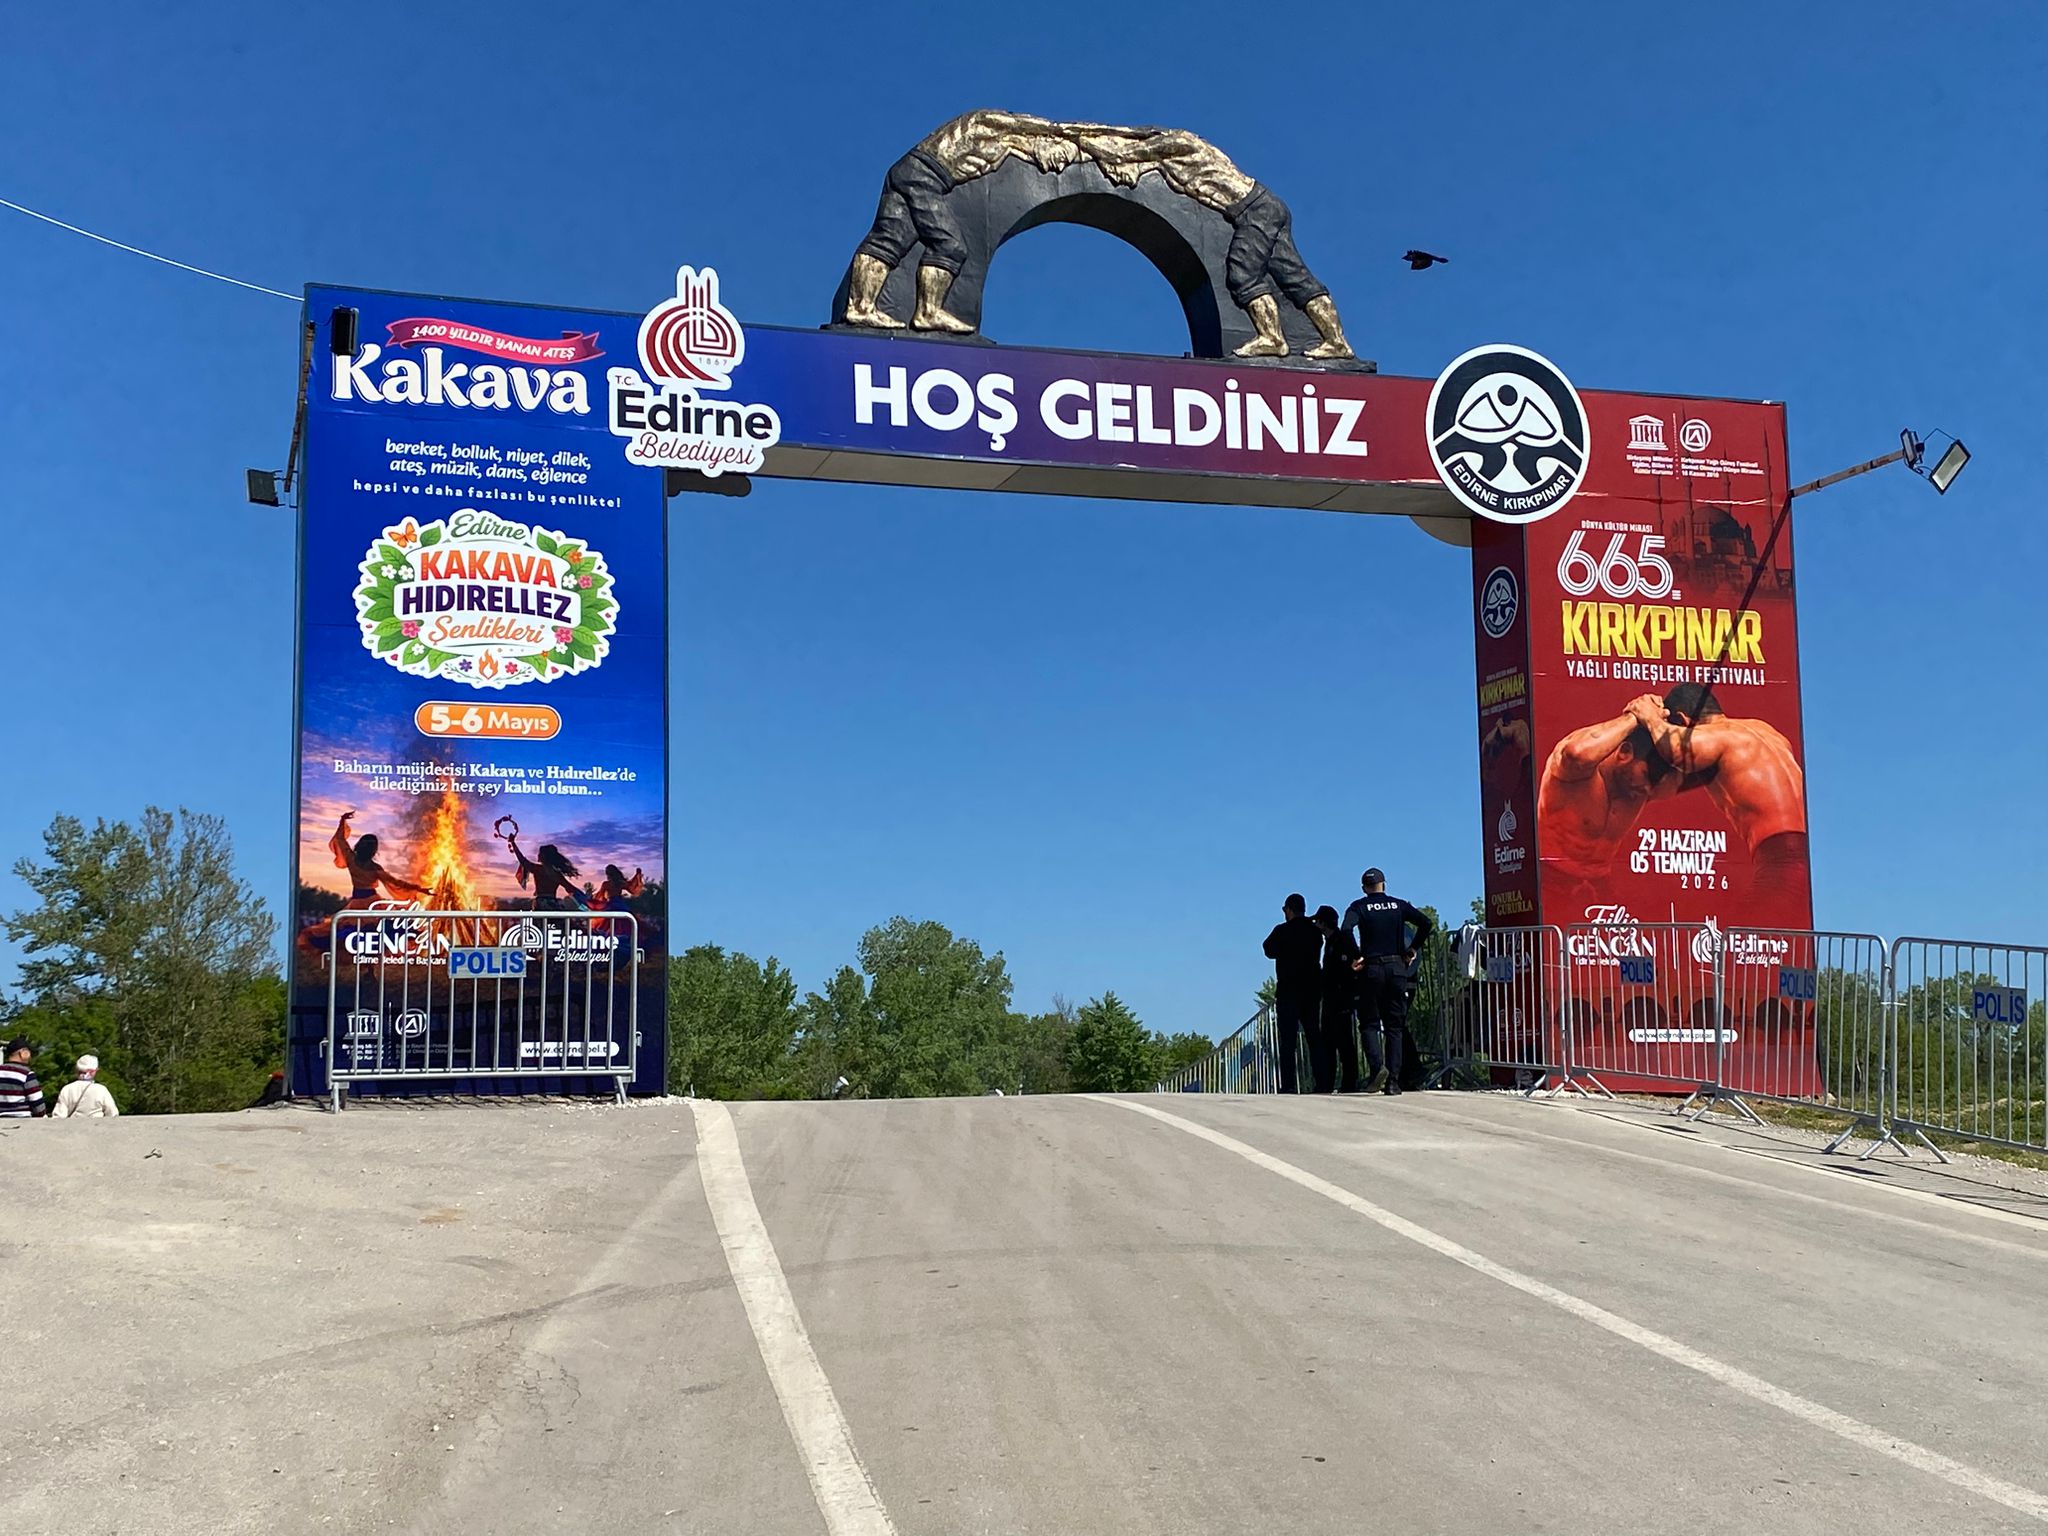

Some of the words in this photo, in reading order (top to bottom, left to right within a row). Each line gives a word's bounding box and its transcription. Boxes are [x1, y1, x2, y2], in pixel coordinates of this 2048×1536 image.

[411, 325, 447, 339] 1400
[450, 327, 494, 346] YILDIR
[495, 337, 542, 357] YANAN
[543, 347, 576, 361] ATEŞ
[331, 343, 591, 415] Kakava
[617, 389, 773, 440] Edirne
[853, 363, 1018, 452] HOŞ
[1039, 378, 1369, 457] GELDİNİZ
[385, 439, 448, 459] bereket,
[451, 443, 502, 463] bolluk,
[506, 448, 548, 467] niyet,
[552, 451, 592, 470] dilek,
[633, 432, 757, 470] Belediyesi
[390, 459, 427, 477] ateş,
[431, 461, 482, 480] müzik,
[485, 466, 527, 483] dans,
[531, 468, 588, 485] eğlence
[1453, 463, 1499, 506] EDİRNE
[1504, 474, 1570, 510] KIRKPINAR
[353, 479, 398, 494] hepsi
[402, 485, 420, 495] ve
[424, 484, 463, 498] daha
[468, 487, 523, 502] fazlası
[528, 491, 546, 503] bu
[550, 493, 622, 508] şenlikte!
[450, 513, 527, 541] Edirne
[420, 550, 557, 588] KAKAVA
[402, 584, 572, 624] HIDIRELLEZ
[428, 615, 545, 646] Şenlikleri
[1561, 600, 1767, 664] KIRKPINAR
[1567, 658, 1608, 679] YAĞLI
[1613, 661, 1690, 686] GÜREŞLERİ
[1695, 666, 1765, 686] FESTİVALİ
[430, 705, 483, 734] 5-6
[488, 711, 549, 735] Mayıs
[334, 760, 393, 775] Baharın
[396, 762, 467, 783] müjdecisi
[469, 764, 525, 778] Kakava
[528, 769, 543, 779] ve
[369, 776, 448, 796] dilediğiniz
[450, 779, 475, 793] her
[477, 783, 502, 797] şey
[504, 780, 545, 795] kabul
[1638, 828, 1657, 851] 29
[1660, 829, 1727, 853] HAZİRAN
[1630, 851, 1649, 873] 05
[1651, 851, 1716, 875] TEMMUZ
[1681, 875, 1728, 890] 2026
[1974, 990, 2025, 1024] POLİS
